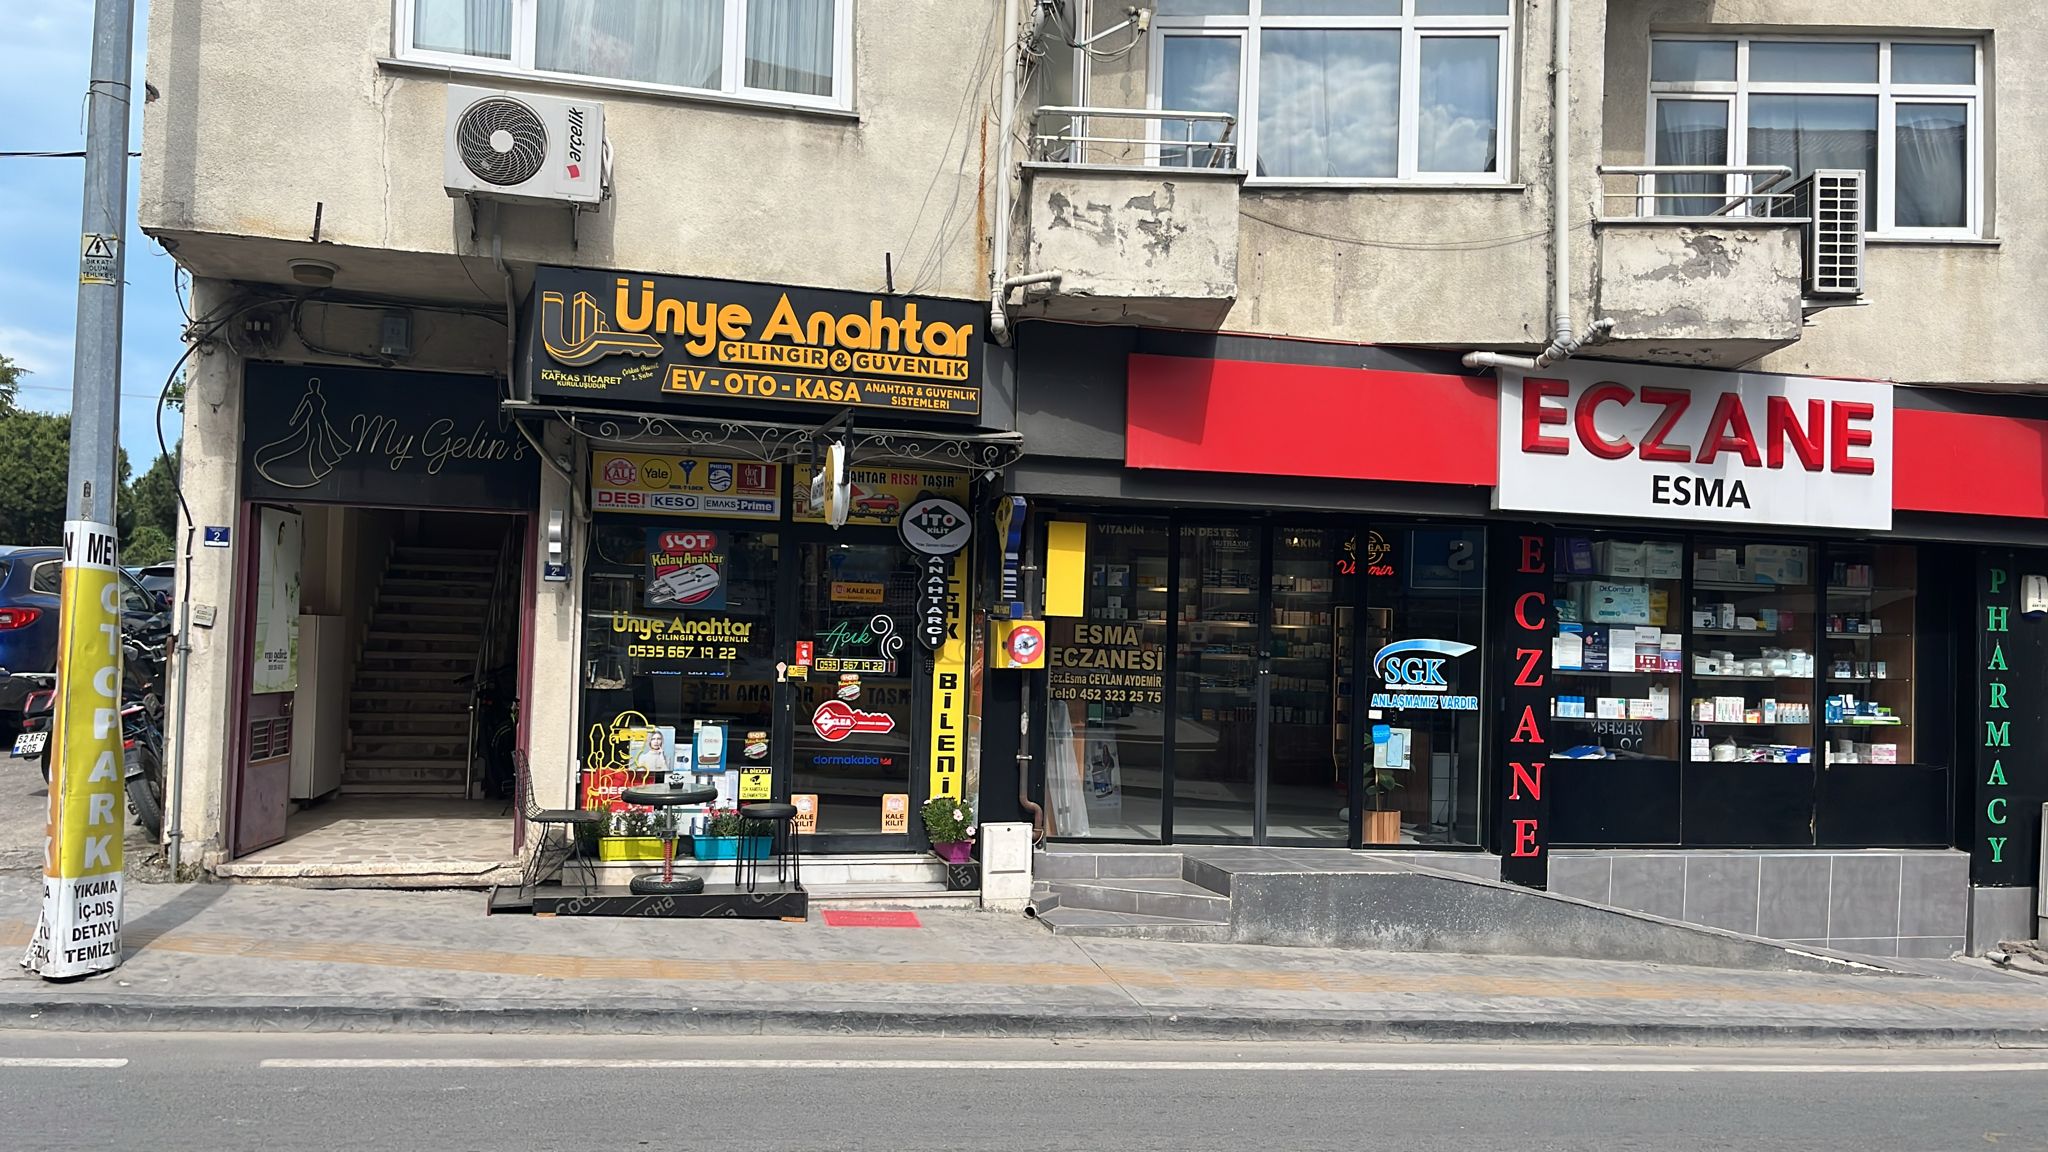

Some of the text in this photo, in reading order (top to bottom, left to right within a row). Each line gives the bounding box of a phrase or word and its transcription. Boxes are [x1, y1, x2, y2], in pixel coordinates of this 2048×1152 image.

[569, 107, 584, 162] arçelik
[615, 278, 973, 357] Ünye Anahtar
[723, 343, 824, 365] ÇİLİNGİR
[834, 352, 847, 367] &
[541, 372, 622, 385] KAFKAS TİCARET
[556, 380, 606, 390] KURULUŞUDUR
[671, 368, 706, 390] EV
[724, 372, 777, 396] OTO
[796, 378, 862, 402] KASA
[864, 383, 914, 396] ANAHTAR
[916, 387, 923, 396] &
[891, 396, 950, 410] SİSTEMLERİ
[1521, 376, 1875, 476] ECZANE
[350, 414, 529, 475] My Gelin's
[604, 467, 636, 483] KALE
[645, 467, 669, 479] Yale
[1651, 474, 1752, 511] ESMA
[654, 496, 695, 508] KESO
[706, 500, 736, 510] EMAKS
[741, 500, 772, 512] Prime
[921, 507, 956, 526] İTO
[213, 531, 221, 541] 2
[926, 526, 950, 535] KİLİT
[1097, 524, 1145, 536] VİTAMİN
[652, 552, 724, 568] Kolay Anahtar
[926, 556, 945, 645] ANAHTARCI
[612, 610, 752, 641] Ünye Anahtar
[1074, 624, 1139, 646] ESMA
[816, 621, 872, 657] Açık
[628, 645, 737, 660] 0535 667 19 22
[1051, 646, 1163, 671] ECZANESİ
[820, 661, 837, 669] 0535
[843, 661, 858, 670] 667
[862, 661, 870, 670] 19
[872, 662, 884, 671] 22
[1384, 657, 1447, 685] SGK
[1050, 671, 1162, 688] Ecz.Esma CEYLAN AYDEMİR
[1079, 688, 1101, 700] 452
[1104, 689, 1126, 701] 323
[1129, 690, 1143, 702] 25
[1147, 691, 1161, 703] 75
[1371, 693, 1478, 712] ANLAŞMAMIZ VARDIR
[1509, 535, 1547, 858] ECZANE
[1984, 568, 2011, 863] PHARMACY
[84, 582, 119, 869] OTOPARK
[18, 733, 46, 744] 52 AFG
[21, 743, 38, 753] 605
[812, 754, 880, 766] dormakaba
[598, 786, 628, 794] DES
[74, 879, 118, 900] YIKAMA
[78, 900, 115, 922] İÇ-DIŞ
[72, 919, 120, 942] DETAYLI
